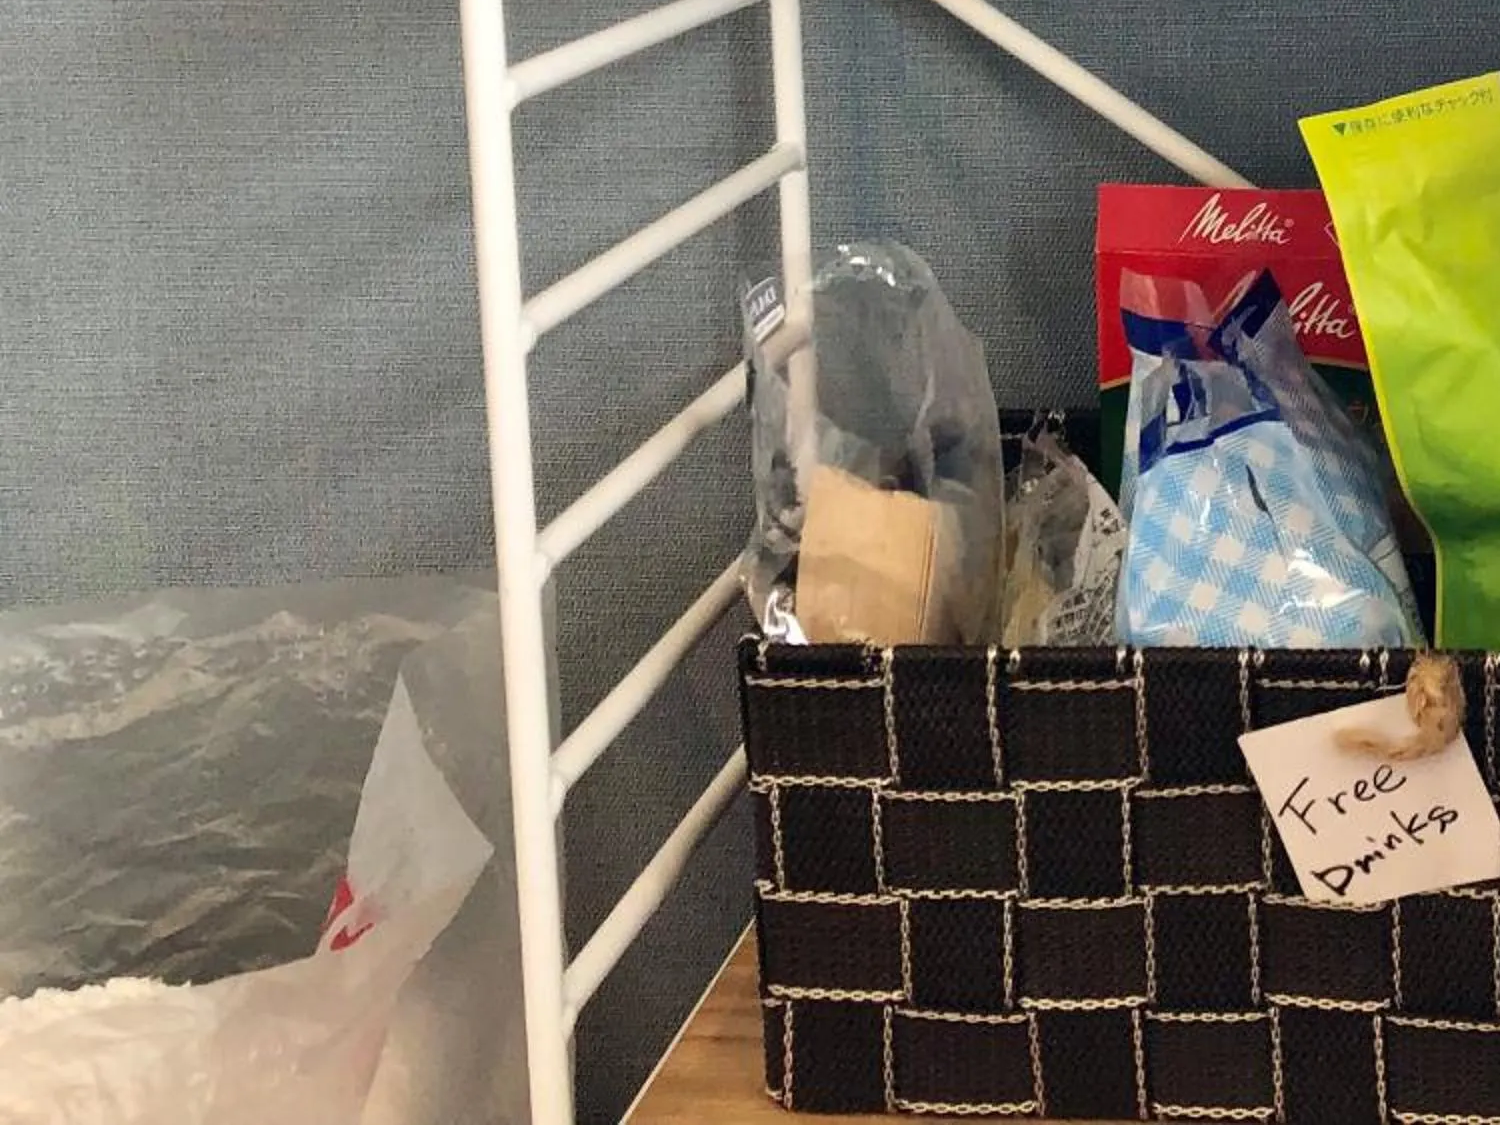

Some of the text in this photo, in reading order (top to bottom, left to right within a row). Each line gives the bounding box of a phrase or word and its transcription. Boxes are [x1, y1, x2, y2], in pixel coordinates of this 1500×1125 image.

[1177, 192, 1293, 245] Melitta
[1277, 763, 1408, 835] Free
[1309, 804, 1459, 897] Drinks
